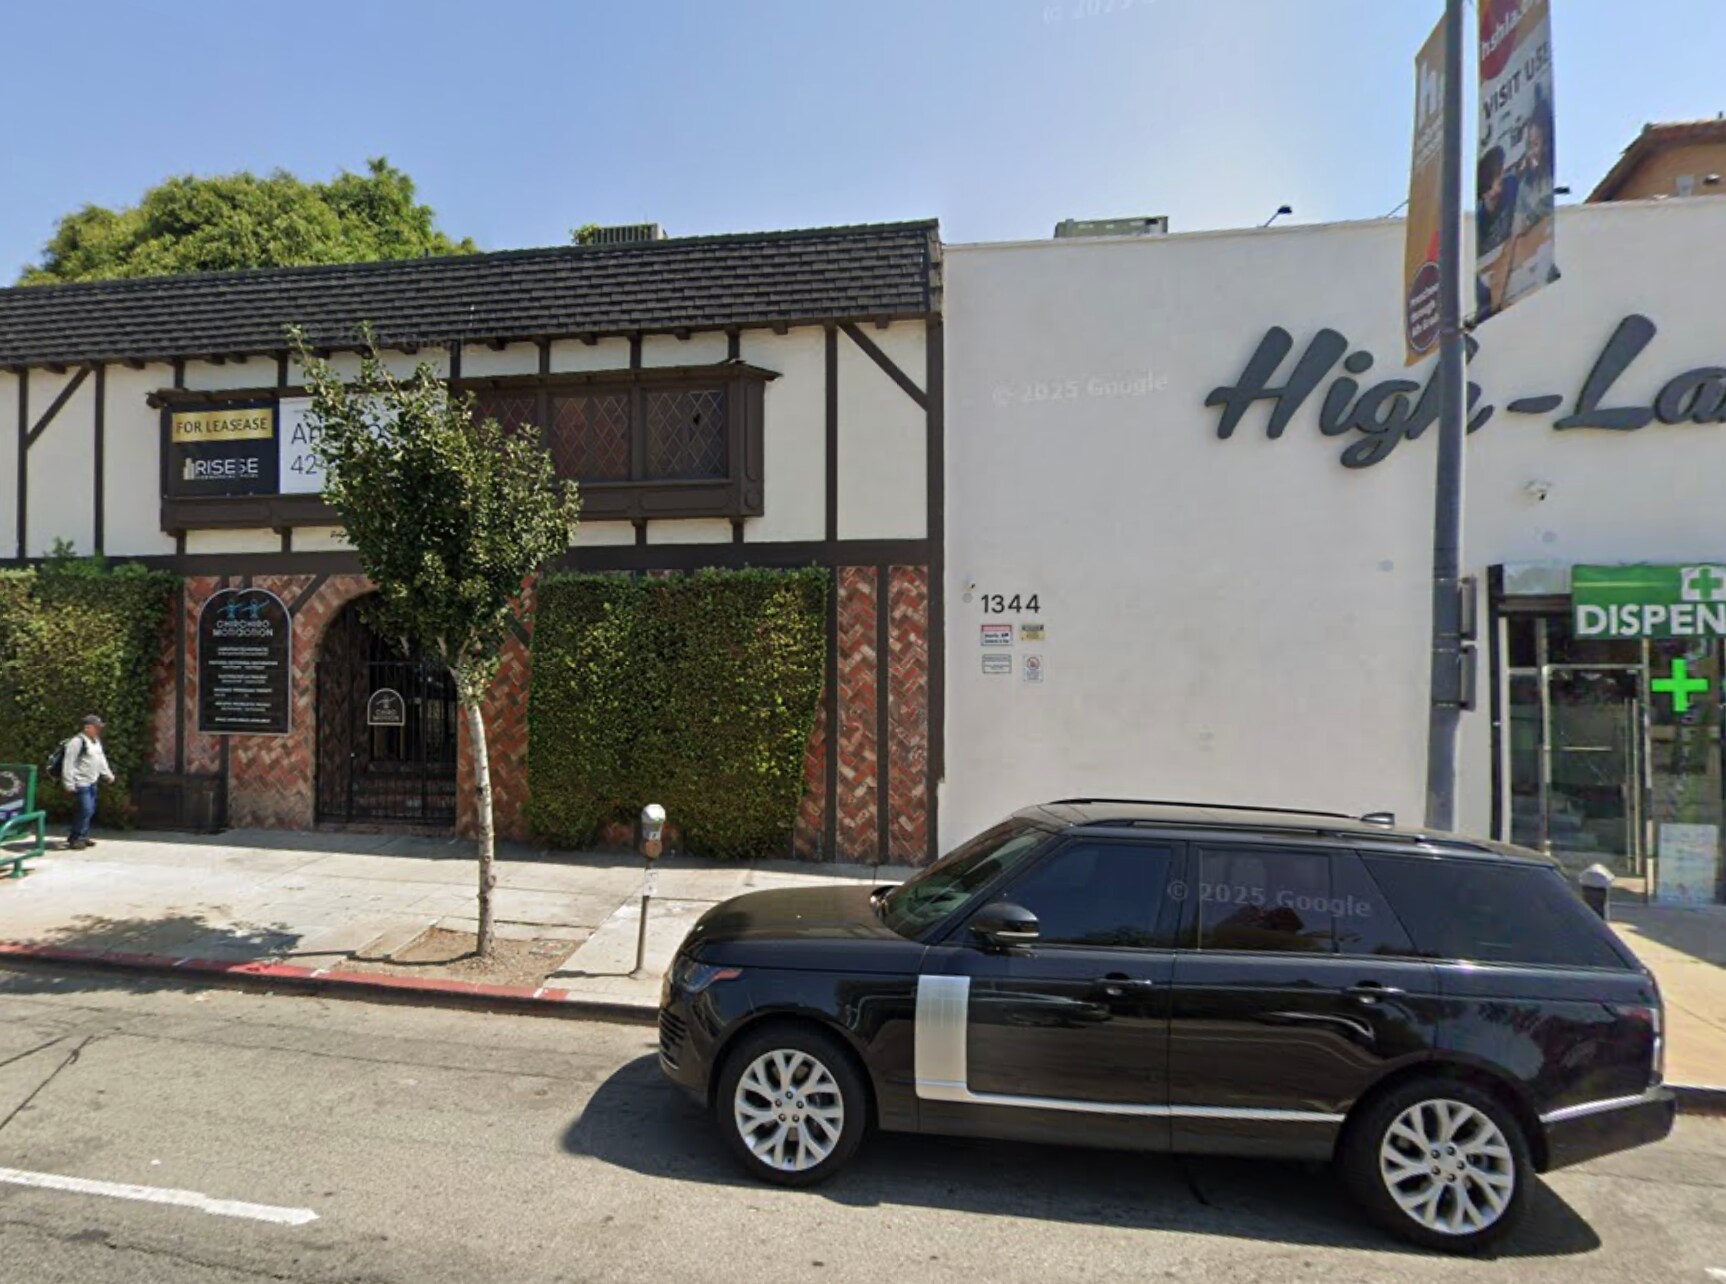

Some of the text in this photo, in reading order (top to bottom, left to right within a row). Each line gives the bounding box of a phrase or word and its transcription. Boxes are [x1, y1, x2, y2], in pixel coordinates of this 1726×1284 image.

[1483, 71, 1521, 119] VISIT
[176, 421, 203, 434] FOR
[980, 593, 1041, 614] 1344
[1576, 603, 1726, 636] DISPEN
